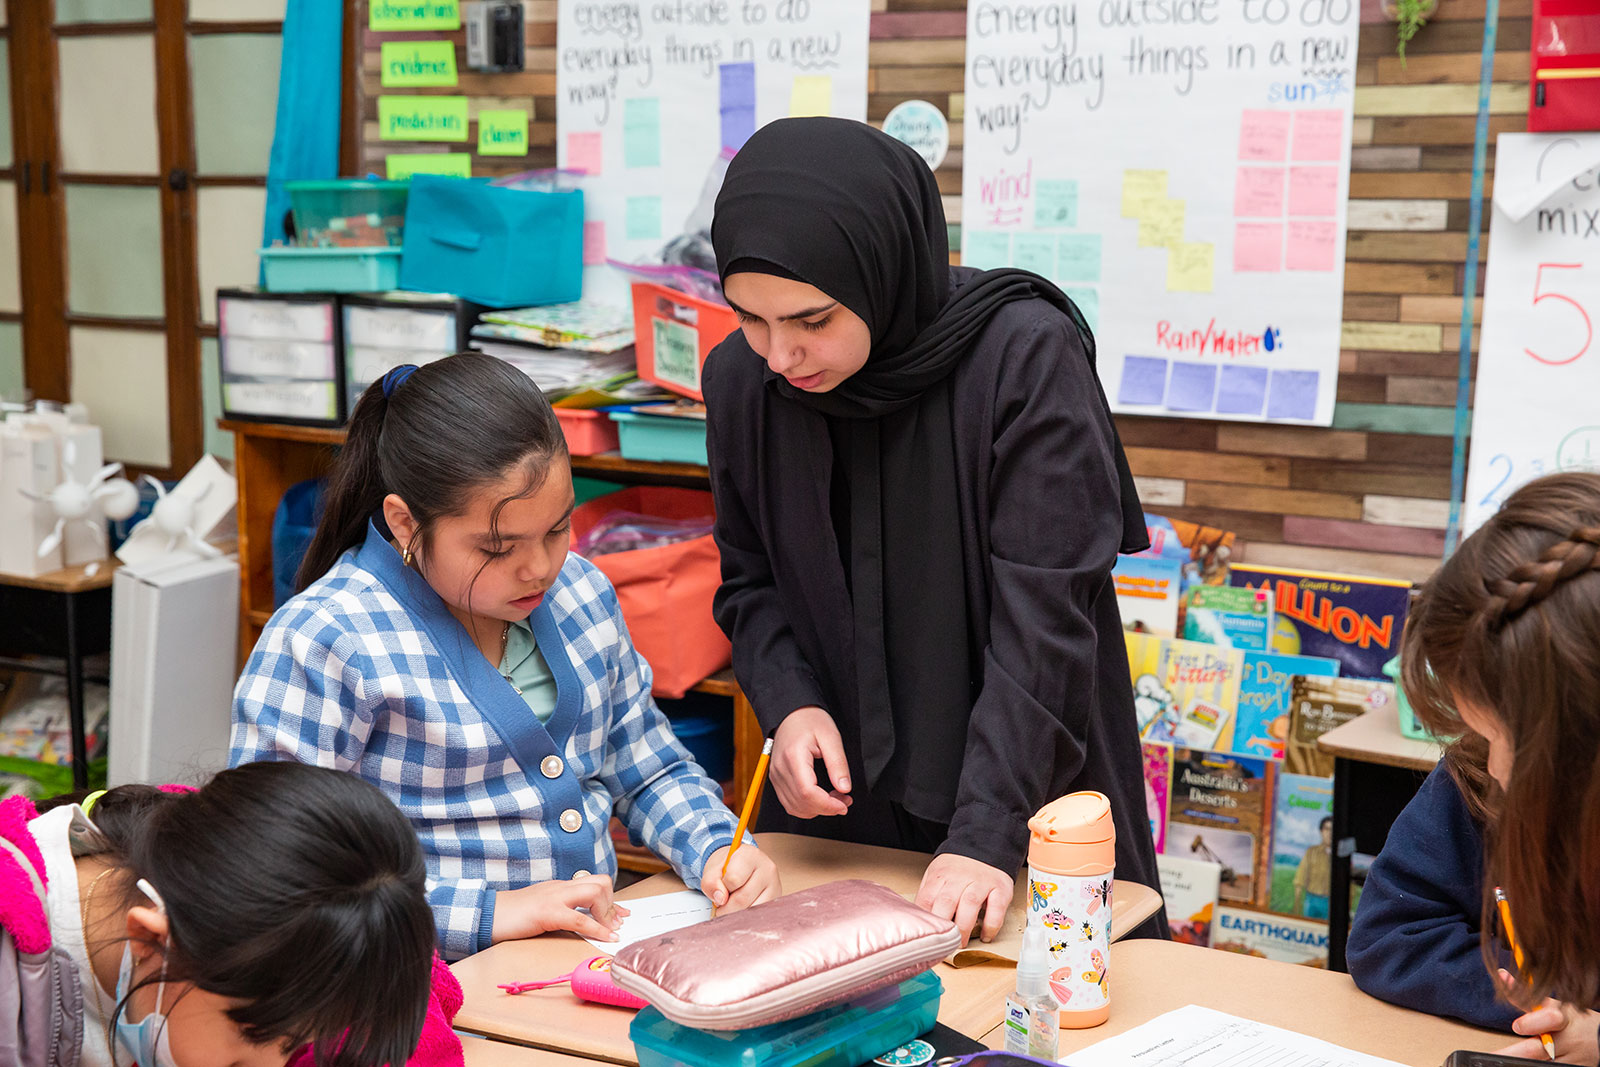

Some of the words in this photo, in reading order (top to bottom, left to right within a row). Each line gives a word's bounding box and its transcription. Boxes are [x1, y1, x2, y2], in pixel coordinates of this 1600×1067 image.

[575, 2, 642, 41] energy
[652, 0, 729, 25] outside
[742, 0, 767, 23] to
[776, 0, 810, 22] do
[975, 1, 1078, 54] energy
[1098, 0, 1219, 28] outside
[1242, 0, 1289, 26] to
[1299, 0, 1352, 26] do
[563, 45, 653, 88] everyday
[665, 33, 722, 79] things
[733, 37, 755, 60] in
[767, 38, 786, 60] a
[790, 30, 842, 58] new
[972, 52, 1105, 111] everyday
[1121, 35, 1209, 96] things
[1227, 43, 1255, 70] in
[1269, 44, 1290, 66] a
[1301, 36, 1349, 65] new
[567, 76, 619, 126] way?
[1267, 81, 1317, 104] sun
[976, 93, 1031, 155] way?
[980, 157, 1033, 204] wind
[1537, 203, 1599, 238] mix
[1524, 260, 1592, 366] 5
[1245, 578, 1395, 650] ILLION
[1163, 648, 1198, 668] First
[1203, 653, 1235, 681] Day
[1169, 663, 1228, 685] Jitters
[1257, 661, 1294, 692] Day
[1181, 768, 1249, 793] Australia's
[1189, 787, 1238, 808] Deserts
[1220, 915, 1330, 949] EARTHQUAK
